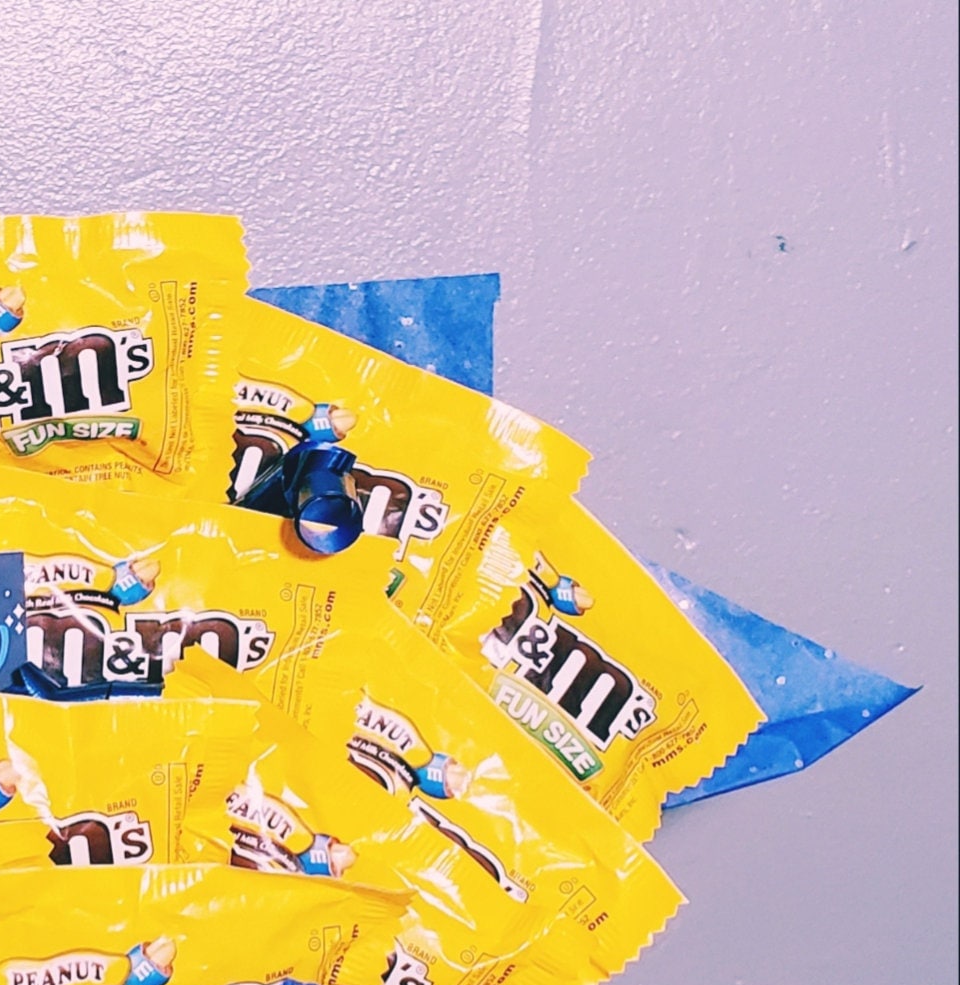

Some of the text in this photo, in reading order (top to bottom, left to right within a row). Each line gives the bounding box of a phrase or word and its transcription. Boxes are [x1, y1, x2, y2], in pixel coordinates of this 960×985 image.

[111, 316, 140, 328] BRAND
[238, 385, 292, 412] ANUT
[11, 422, 134, 453] FUN SIZE
[74, 461, 112, 474] CONTAINS
[419, 476, 449, 490] BRAND
[476, 480, 526, 556] mms.com
[240, 608, 268, 618] BRAND
[641, 678, 663, 700] BRAND
[357, 710, 413, 751] ANUT
[494, 684, 596, 776] FUN SIZE
[106, 798, 138, 812] BRAND
[226, 791, 292, 839] EANUT
[407, 943, 438, 965] BRAND
[265, 966, 294, 982] BRAND
